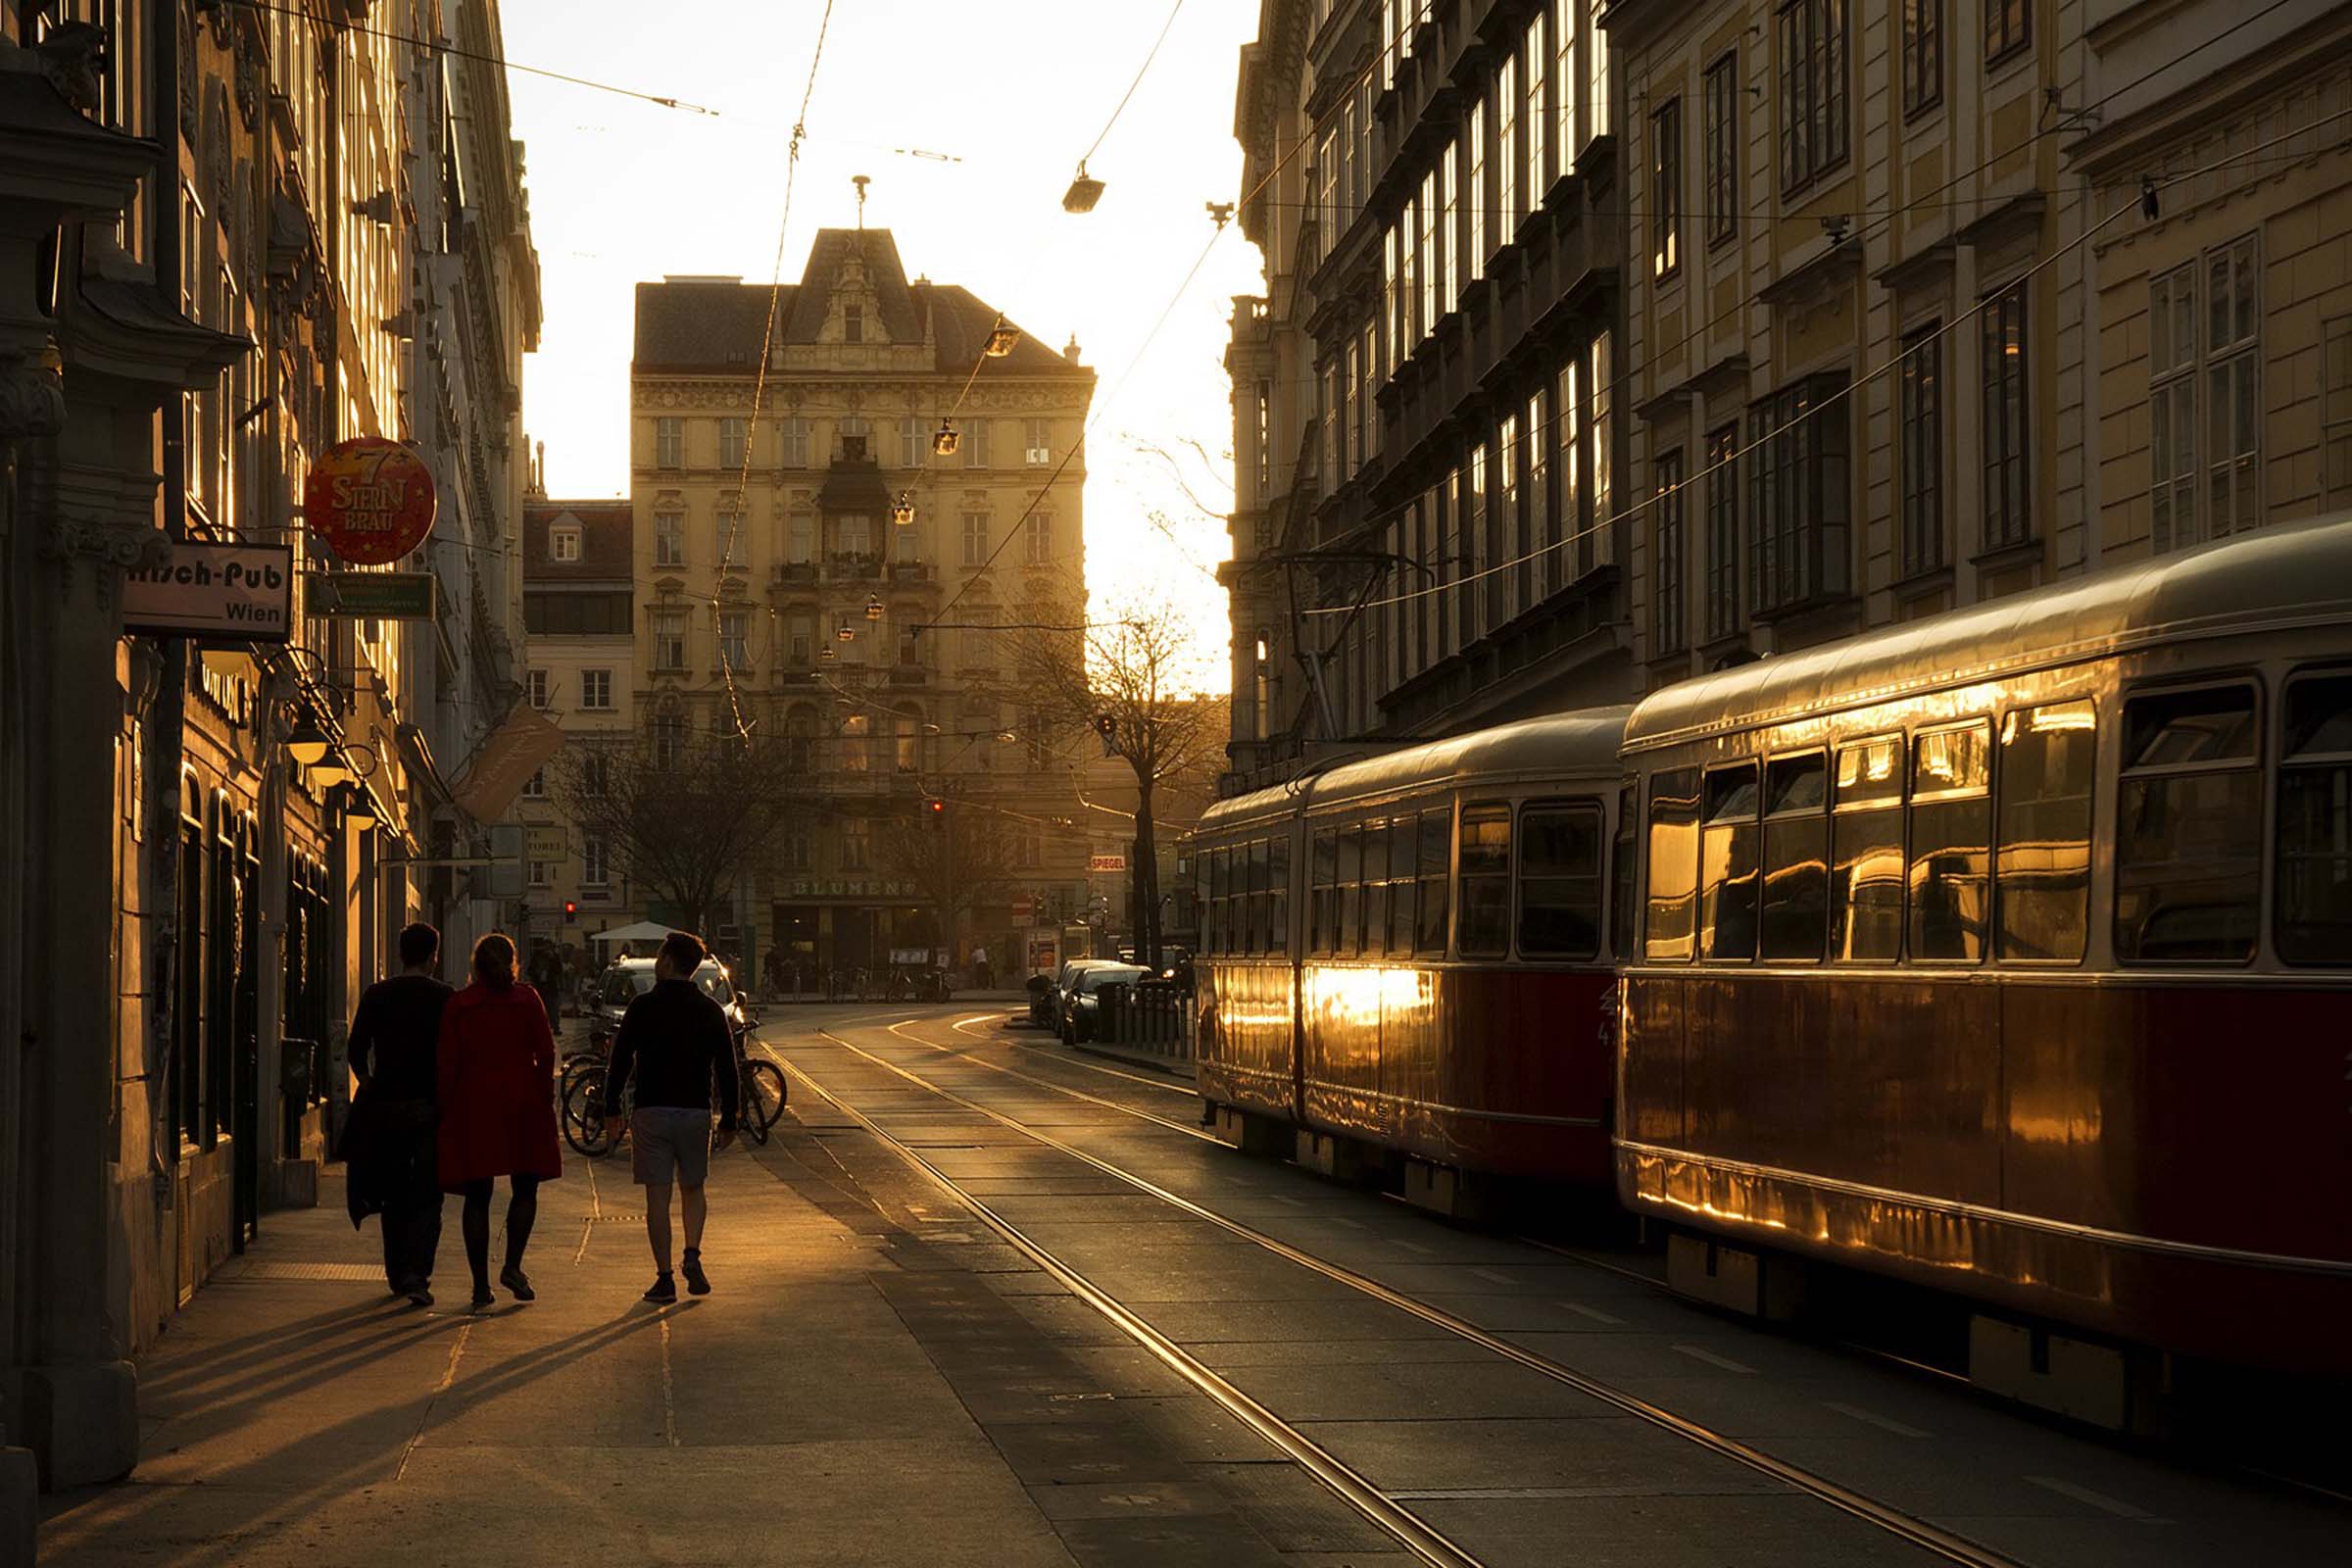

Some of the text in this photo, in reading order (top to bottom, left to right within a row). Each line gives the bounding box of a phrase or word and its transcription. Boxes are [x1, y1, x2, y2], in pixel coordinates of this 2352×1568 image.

[354, 445, 391, 486] 7
[226, 603, 280, 621] Wien
[1092, 858, 1124, 869] SPIEGEL
